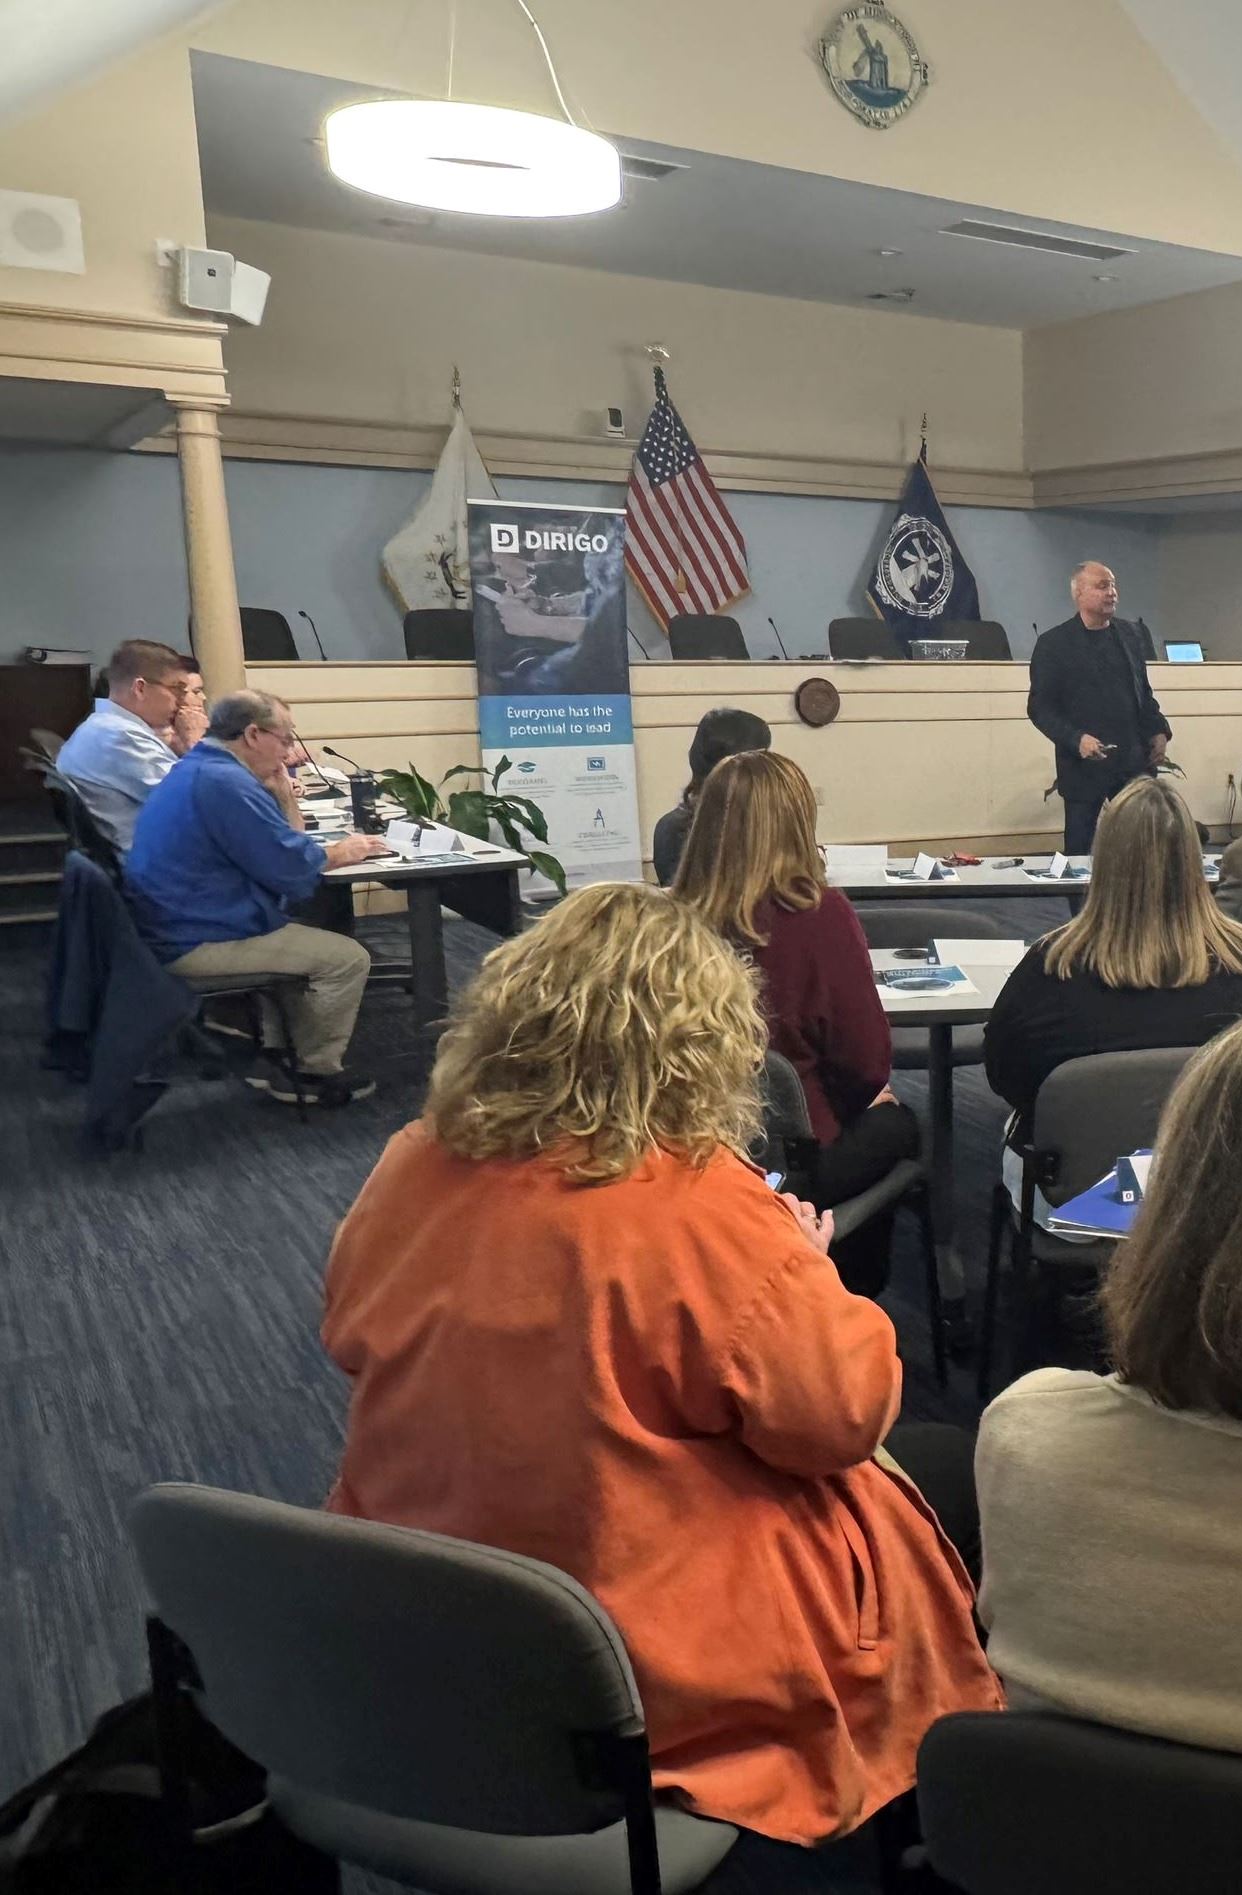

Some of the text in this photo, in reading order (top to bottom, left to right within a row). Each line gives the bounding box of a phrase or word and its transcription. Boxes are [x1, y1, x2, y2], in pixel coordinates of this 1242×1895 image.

[525, 530, 608, 553] DIRIGO
[507, 705, 613, 720] Everyone has the
[509, 723, 566, 739] potential
[570, 724, 583, 734] to
